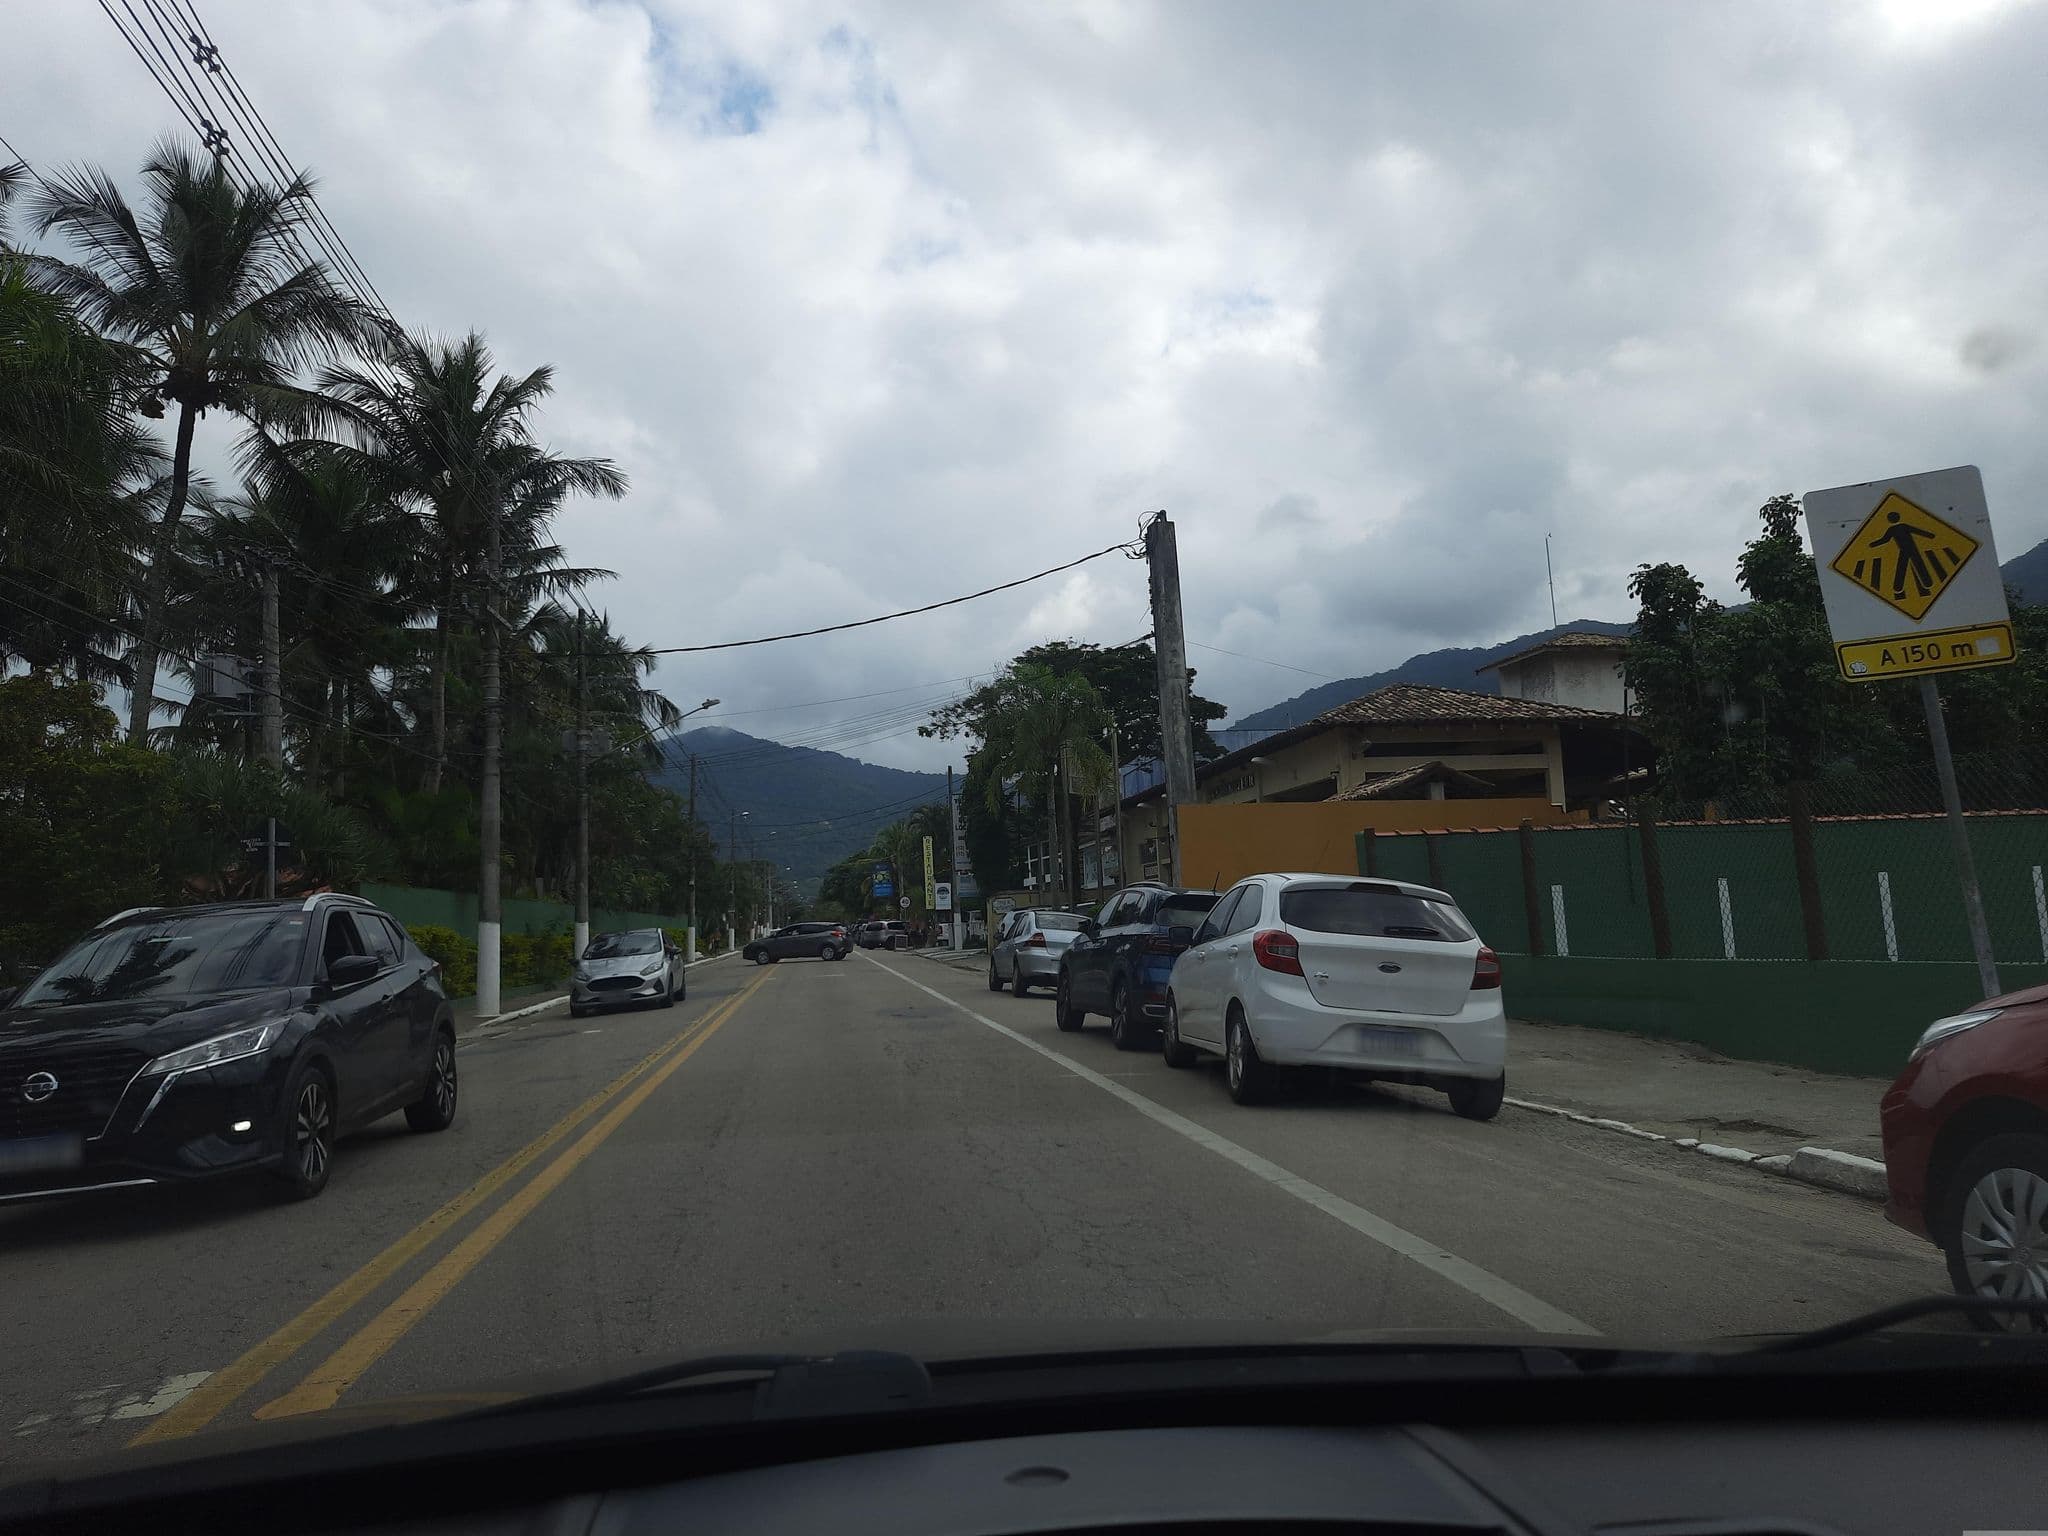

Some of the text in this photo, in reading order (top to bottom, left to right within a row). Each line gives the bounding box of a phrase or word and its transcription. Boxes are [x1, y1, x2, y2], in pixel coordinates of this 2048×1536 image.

[1880, 642, 1974, 667] A 150 m
[925, 839, 933, 906] RESTAURANTE
